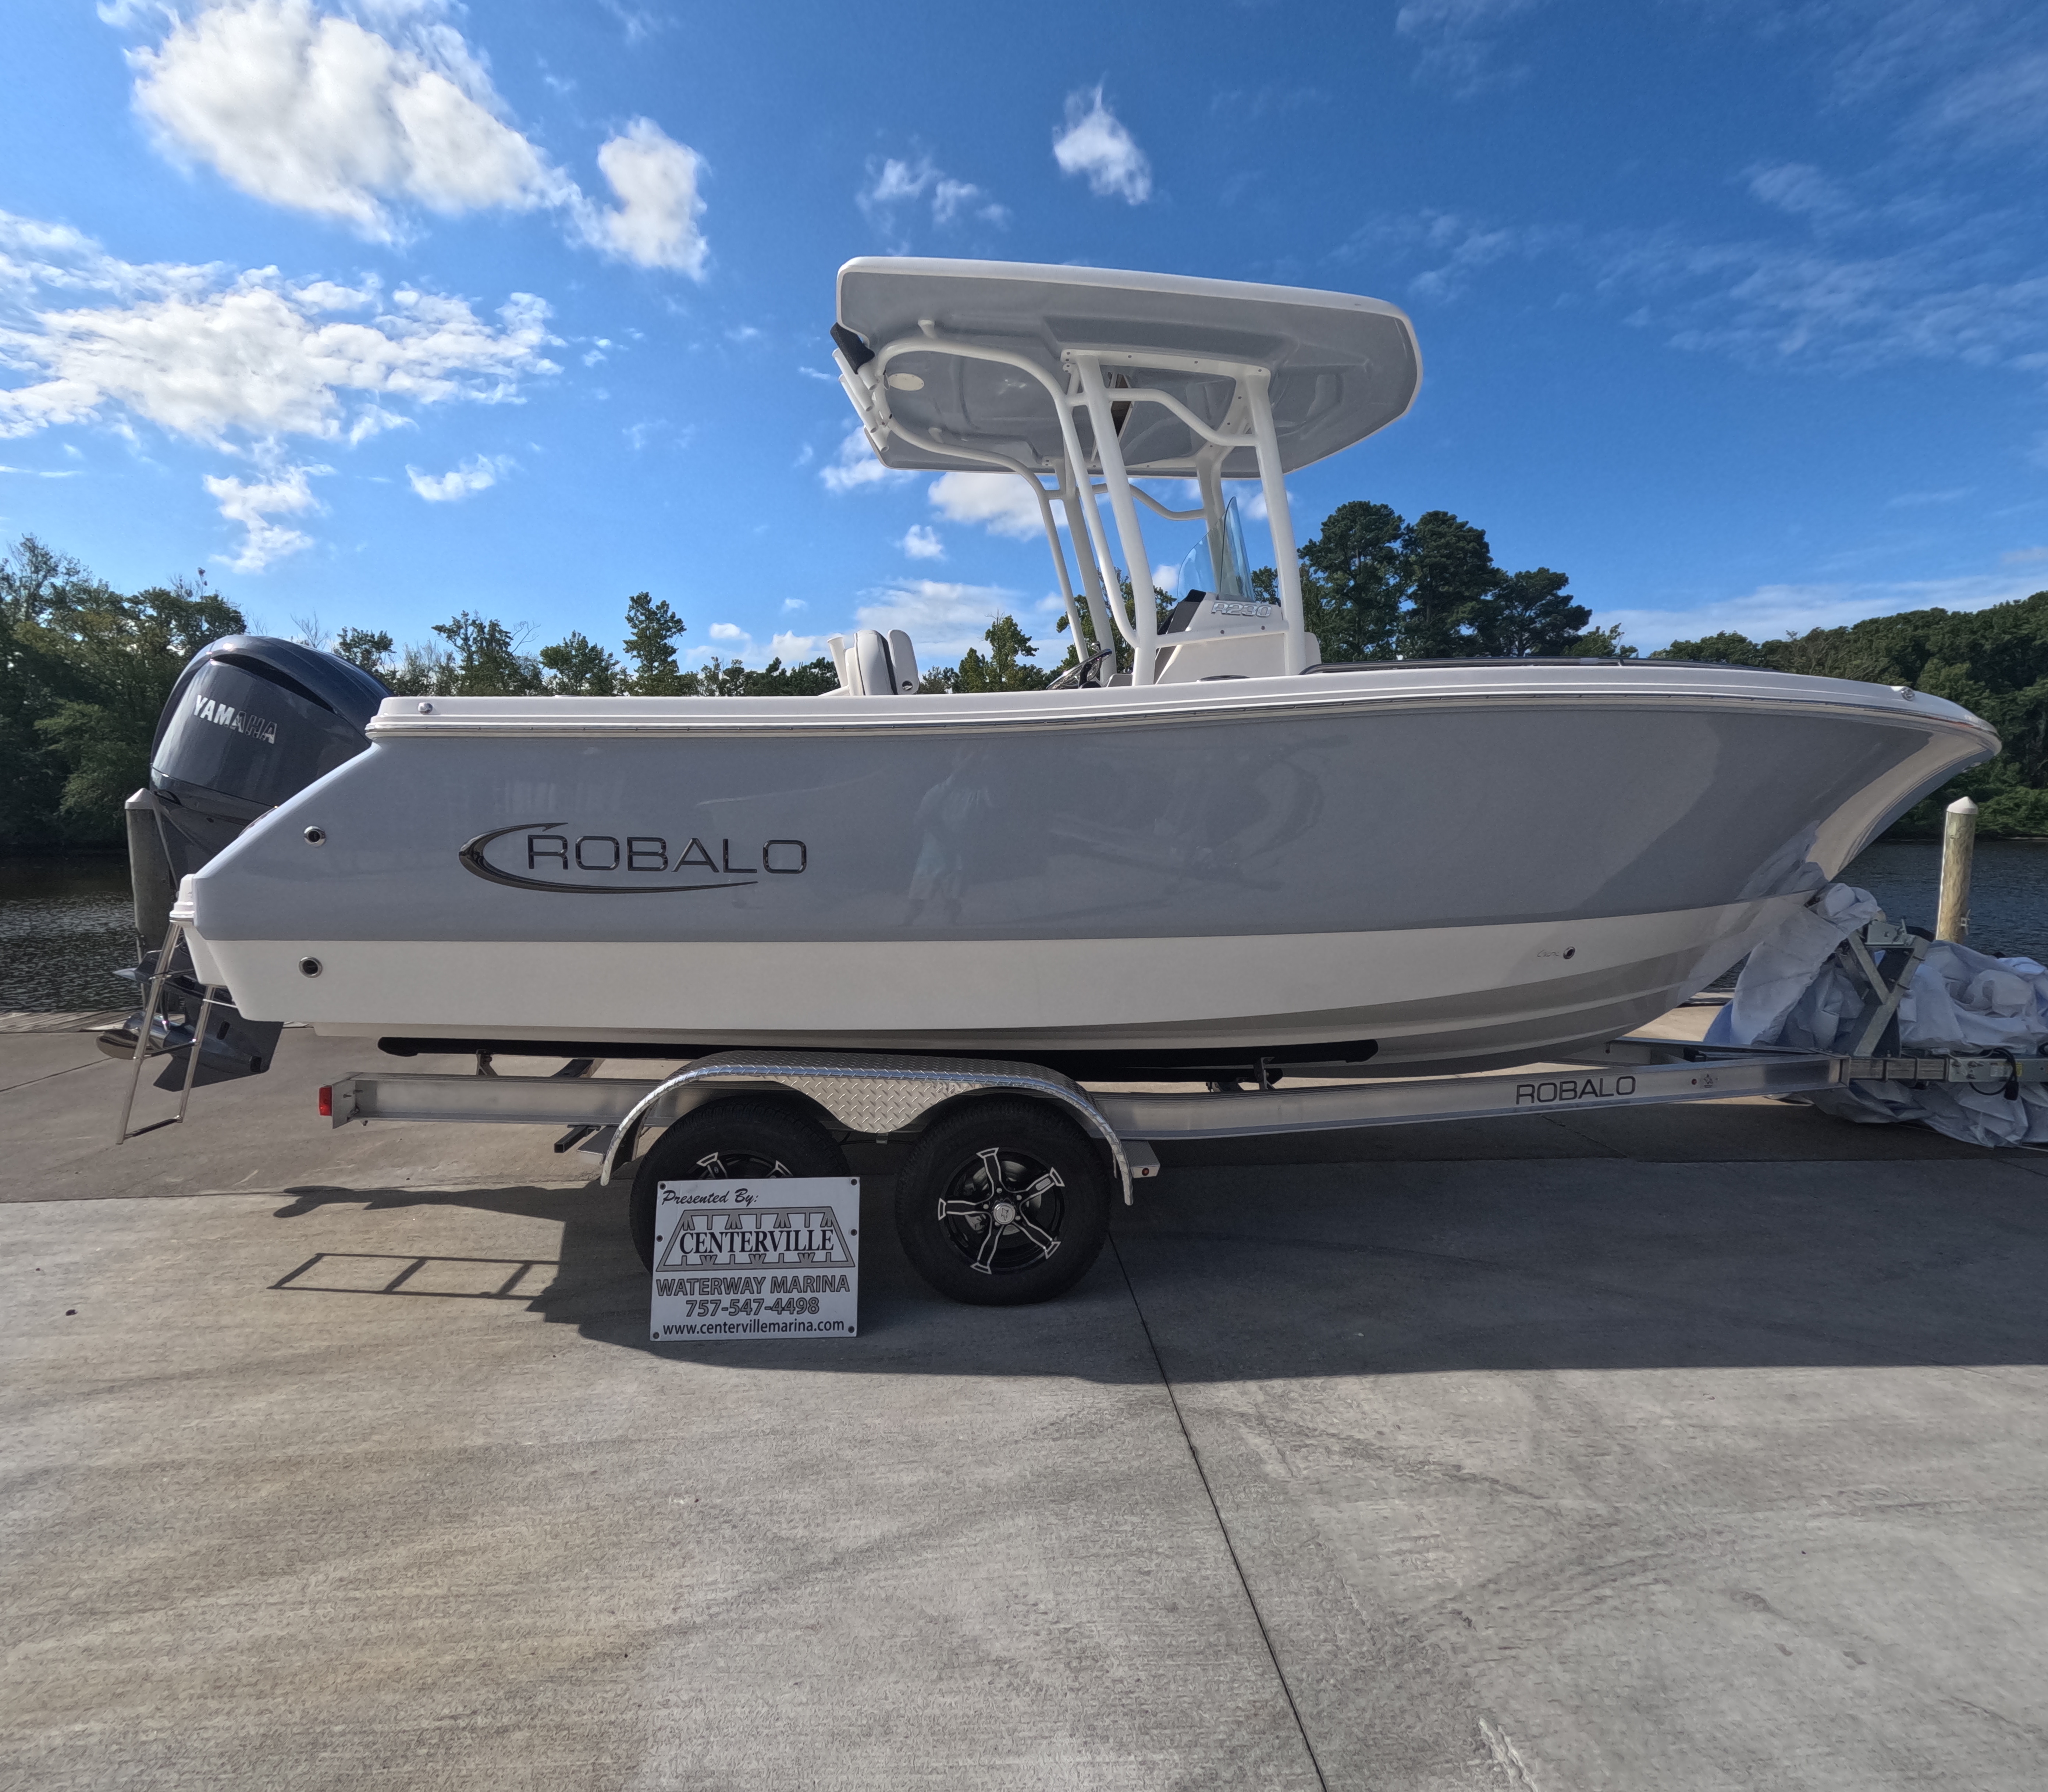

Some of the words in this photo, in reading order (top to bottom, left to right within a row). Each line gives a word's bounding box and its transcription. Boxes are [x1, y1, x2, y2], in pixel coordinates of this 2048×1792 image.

[1211, 602, 1272, 618] R230
[194, 695, 277, 744] YAMAHA
[527, 835, 807, 874] ROBALO
[1516, 1076, 1636, 1105] ROBALO
[662, 1190, 730, 1205] Presented
[735, 1188, 759, 1207] By:
[679, 1229, 834, 1254] CENTERVILLE
[656, 1277, 766, 1297] WATERWAY
[770, 1275, 850, 1294] MARINA
[686, 1297, 819, 1317] 757-547-4498
[663, 1318, 845, 1335] www.centervillemarina.com
